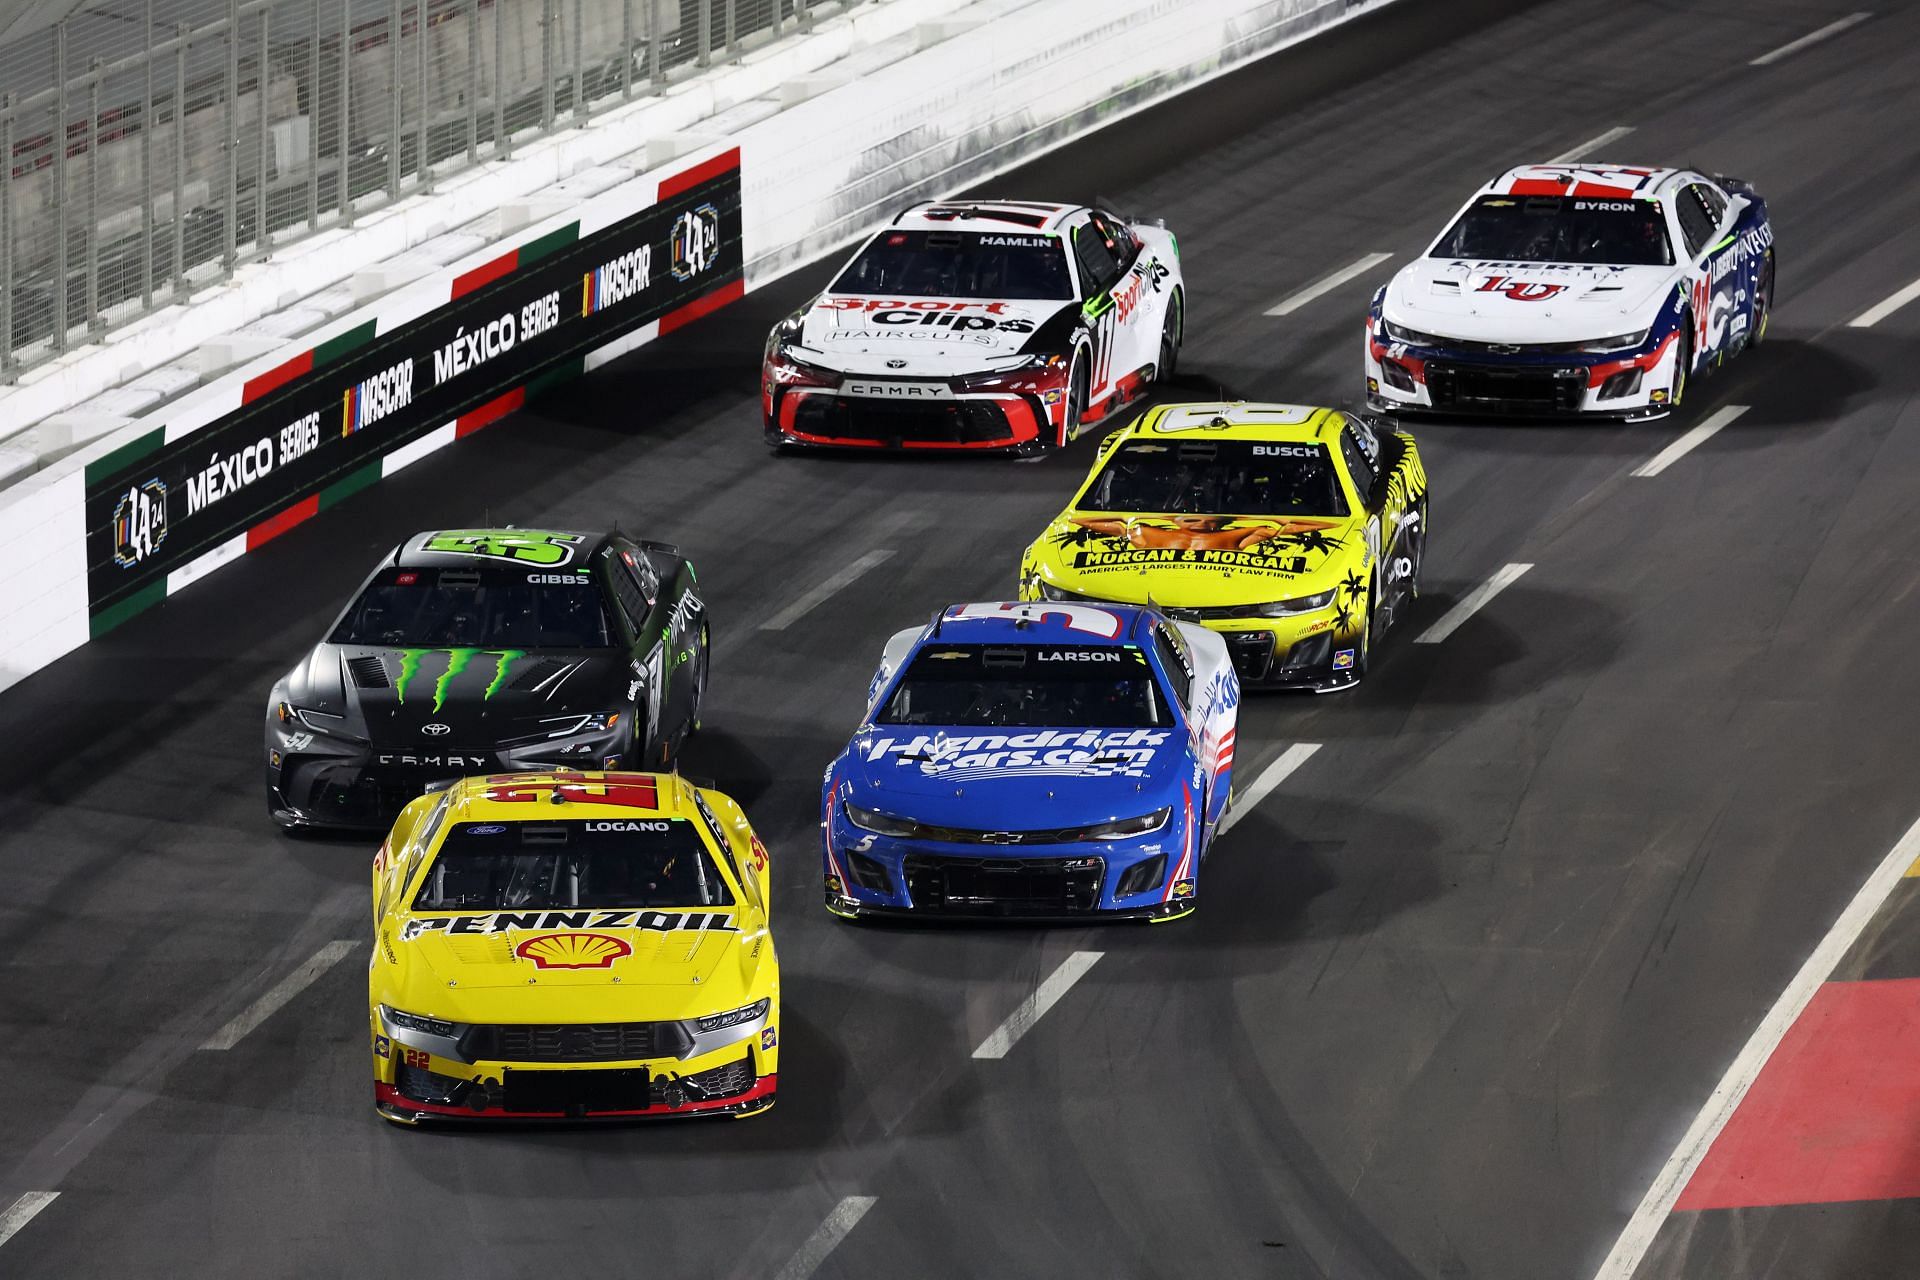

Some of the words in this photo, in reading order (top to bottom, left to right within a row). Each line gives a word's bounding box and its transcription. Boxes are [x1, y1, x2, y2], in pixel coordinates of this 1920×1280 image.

[1574, 201, 1636, 212] BYRON
[703, 223, 715, 249] 24
[979, 236, 1052, 248] HAMLIN
[817, 298, 1010, 315] Sport
[872, 310, 1036, 334] Clips
[359, 357, 414, 430] NASCAR
[433, 312, 516, 386] MÉXICO
[520, 290, 560, 342] SERIES
[599, 243, 651, 311] NASCAR
[832, 331, 991, 345] HAIRCUTS
[851, 385, 945, 397] CAMRY
[1252, 445, 1320, 458] BUSCH
[151, 501, 163, 529] 24
[186, 437, 274, 517] MÉXICO
[279, 411, 320, 466] SERIES
[1085, 549, 1176, 566] MORGAN
[1181, 549, 1197, 561] &
[1203, 551, 1297, 571] MORGAN
[526, 573, 590, 586] GIBBS
[1079, 564, 1140, 576] AMERICA'S
[1142, 563, 1192, 571] LARGEST
[1195, 563, 1236, 573] INJURY
[1239, 567, 1265, 575] LAW
[1266, 571, 1296, 580] FIRM
[1037, 651, 1121, 662] LARSON
[867, 729, 1172, 764] Hendrick
[585, 821, 670, 832] LOGANO
[855, 834, 879, 852] 5
[400, 910, 743, 941] PENNZOIL
[407, 1049, 431, 1070] 22
